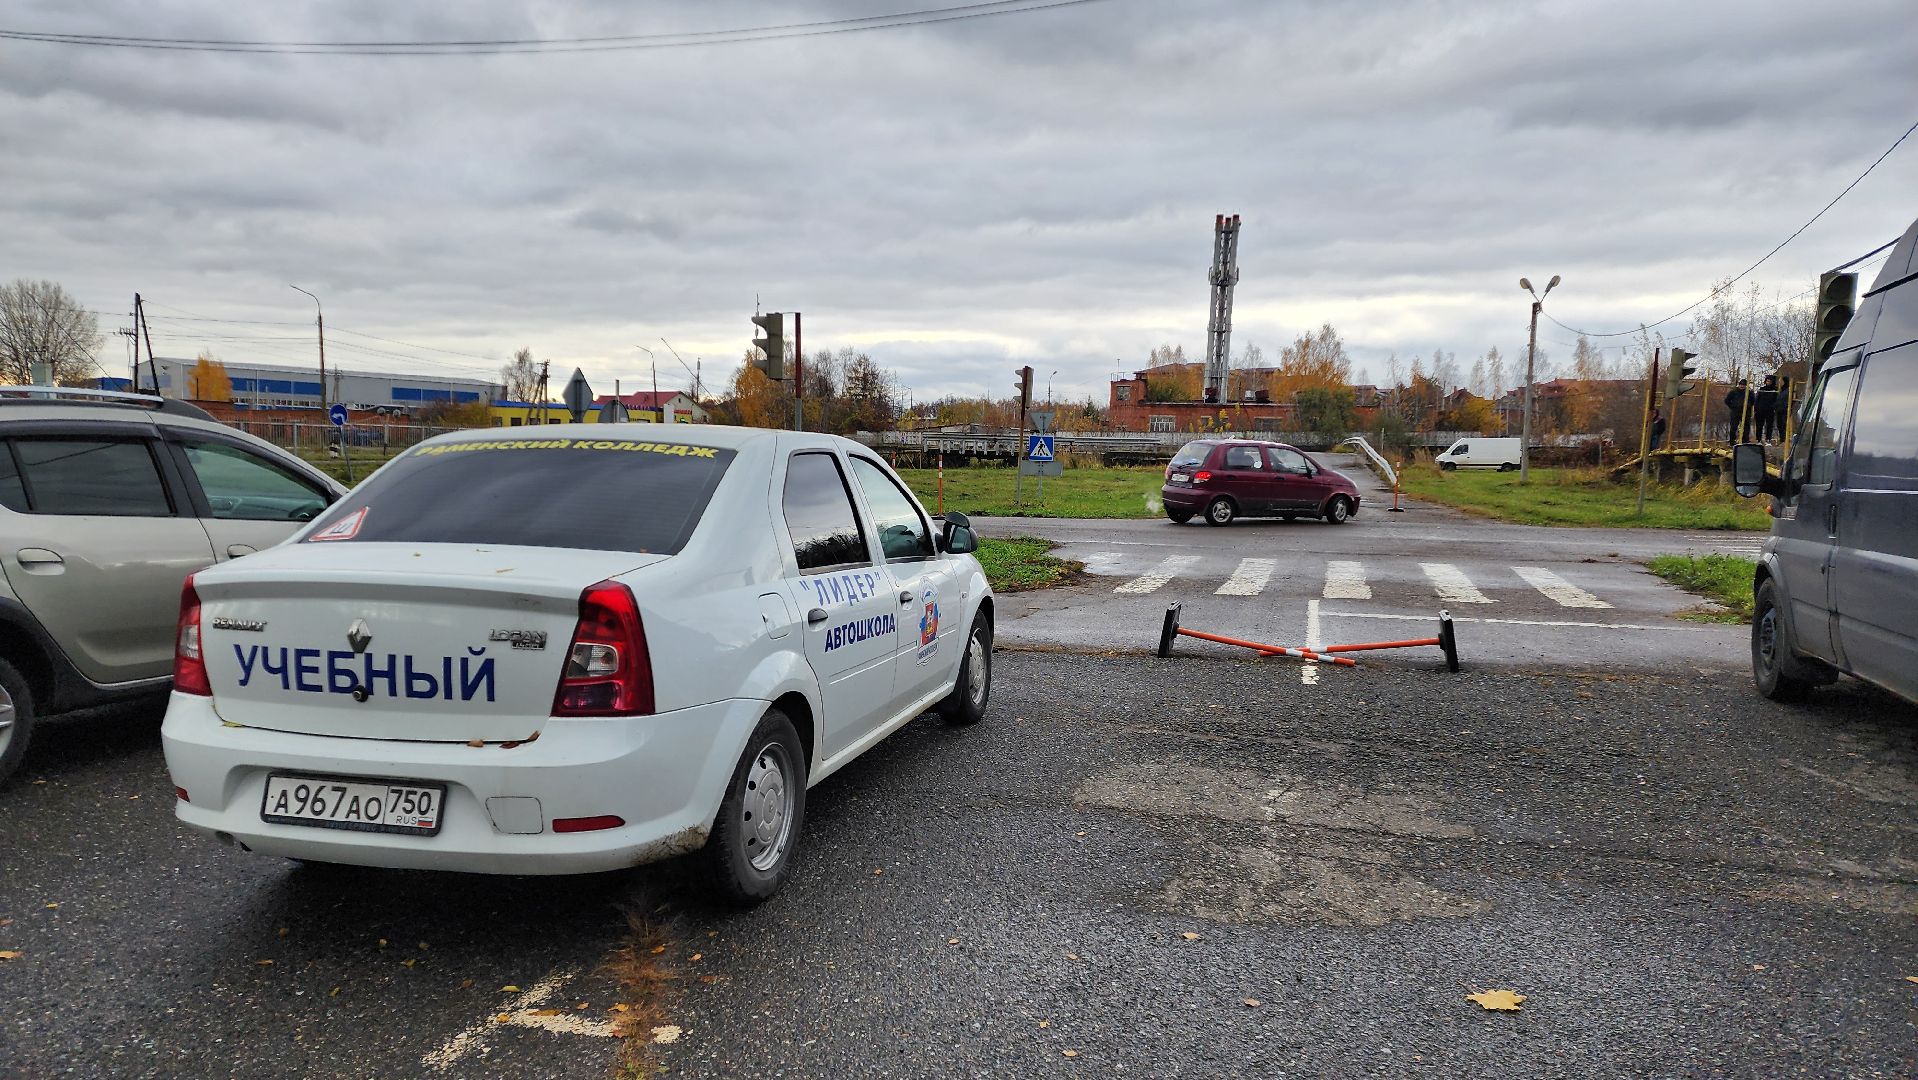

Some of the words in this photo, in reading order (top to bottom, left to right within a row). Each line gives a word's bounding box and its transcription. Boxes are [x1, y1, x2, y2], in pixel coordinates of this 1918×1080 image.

[573, 440, 718, 458] КОЛЛЕДЖ
[212, 616, 267, 632] RENAULT
[824, 612, 896, 652] АВТОШКОЛА
[233, 643, 496, 702] УЧЕБНЫЙ
[389, 788, 432, 816] 750
[395, 815, 417, 825] RUS
